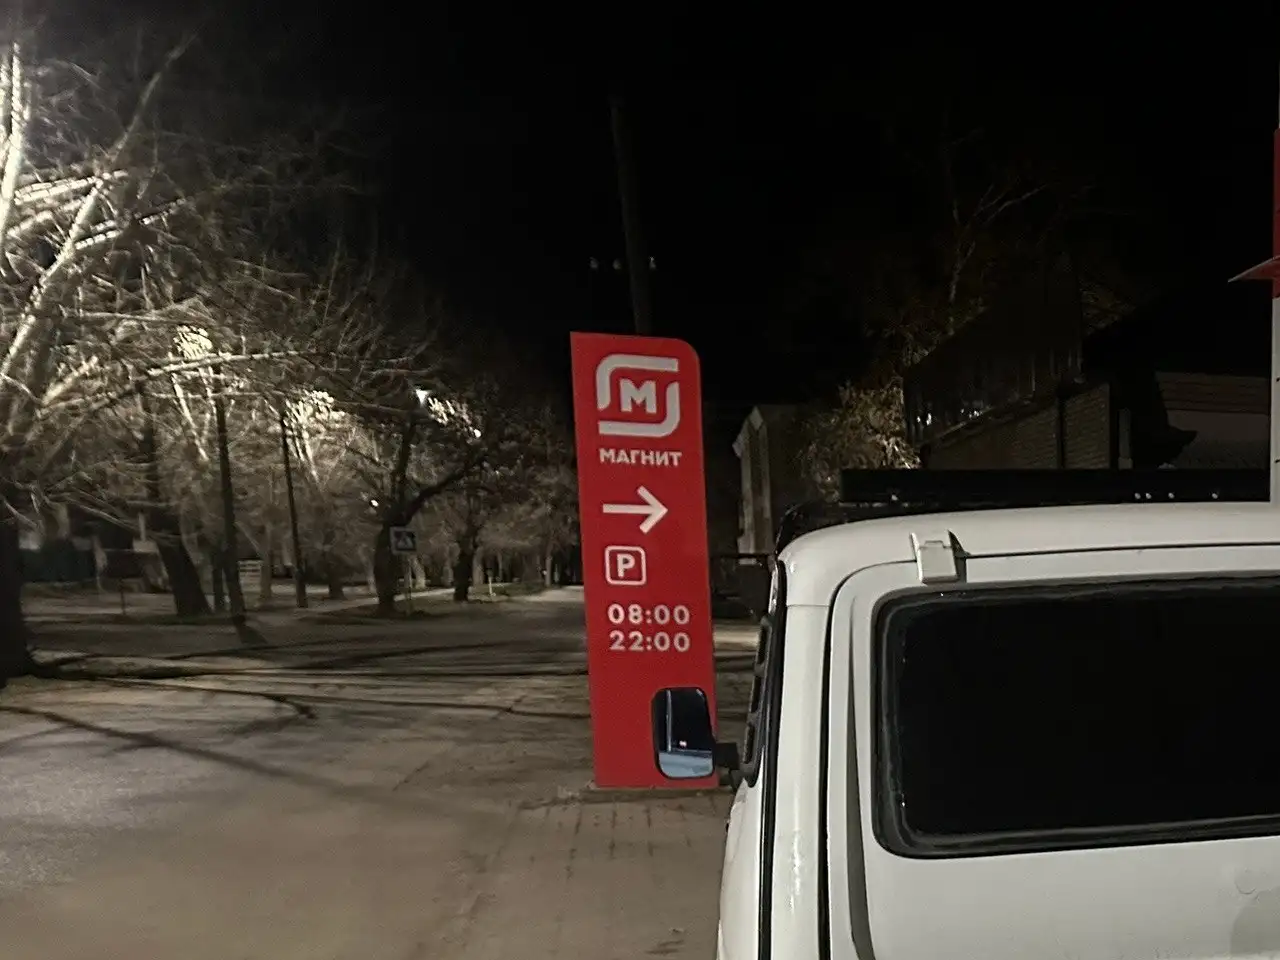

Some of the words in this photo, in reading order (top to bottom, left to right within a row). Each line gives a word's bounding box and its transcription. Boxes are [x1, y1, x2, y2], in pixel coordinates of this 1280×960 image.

[599, 448, 683, 467] МАГНИТ
[607, 603, 690, 625] 08:00
[608, 630, 690, 653] 22:00
